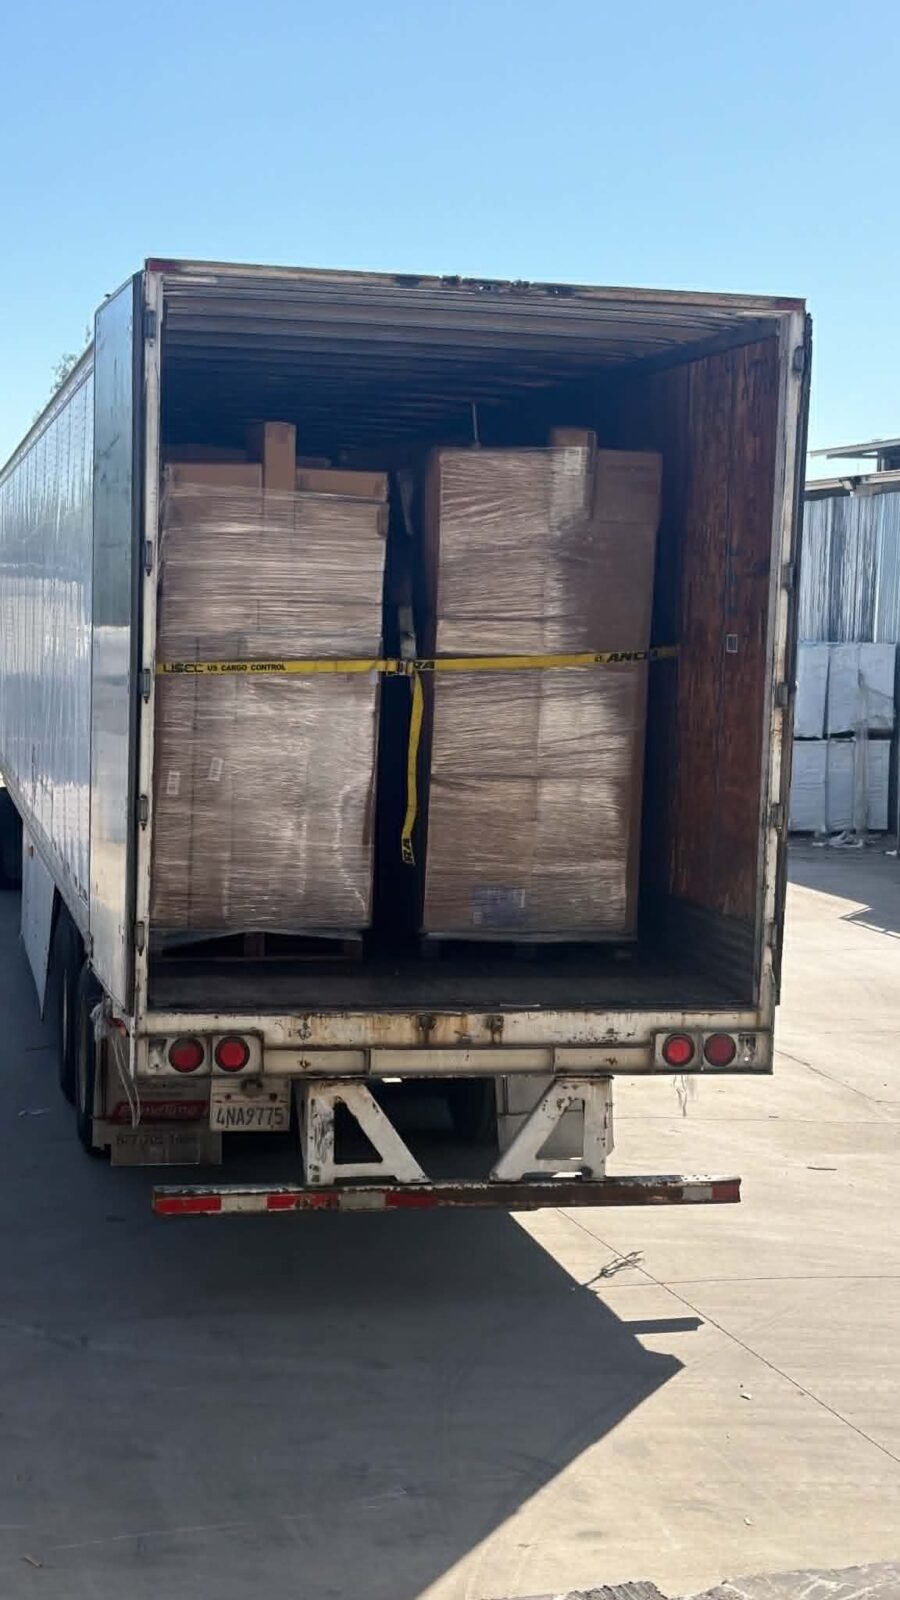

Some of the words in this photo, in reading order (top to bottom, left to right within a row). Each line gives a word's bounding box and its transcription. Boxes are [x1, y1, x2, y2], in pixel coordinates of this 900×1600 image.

[207, 664, 218, 672] US
[221, 664, 248, 672] CARGO
[250, 663, 287, 672] CONTROL
[215, 1106, 285, 1127] 4NA9775
